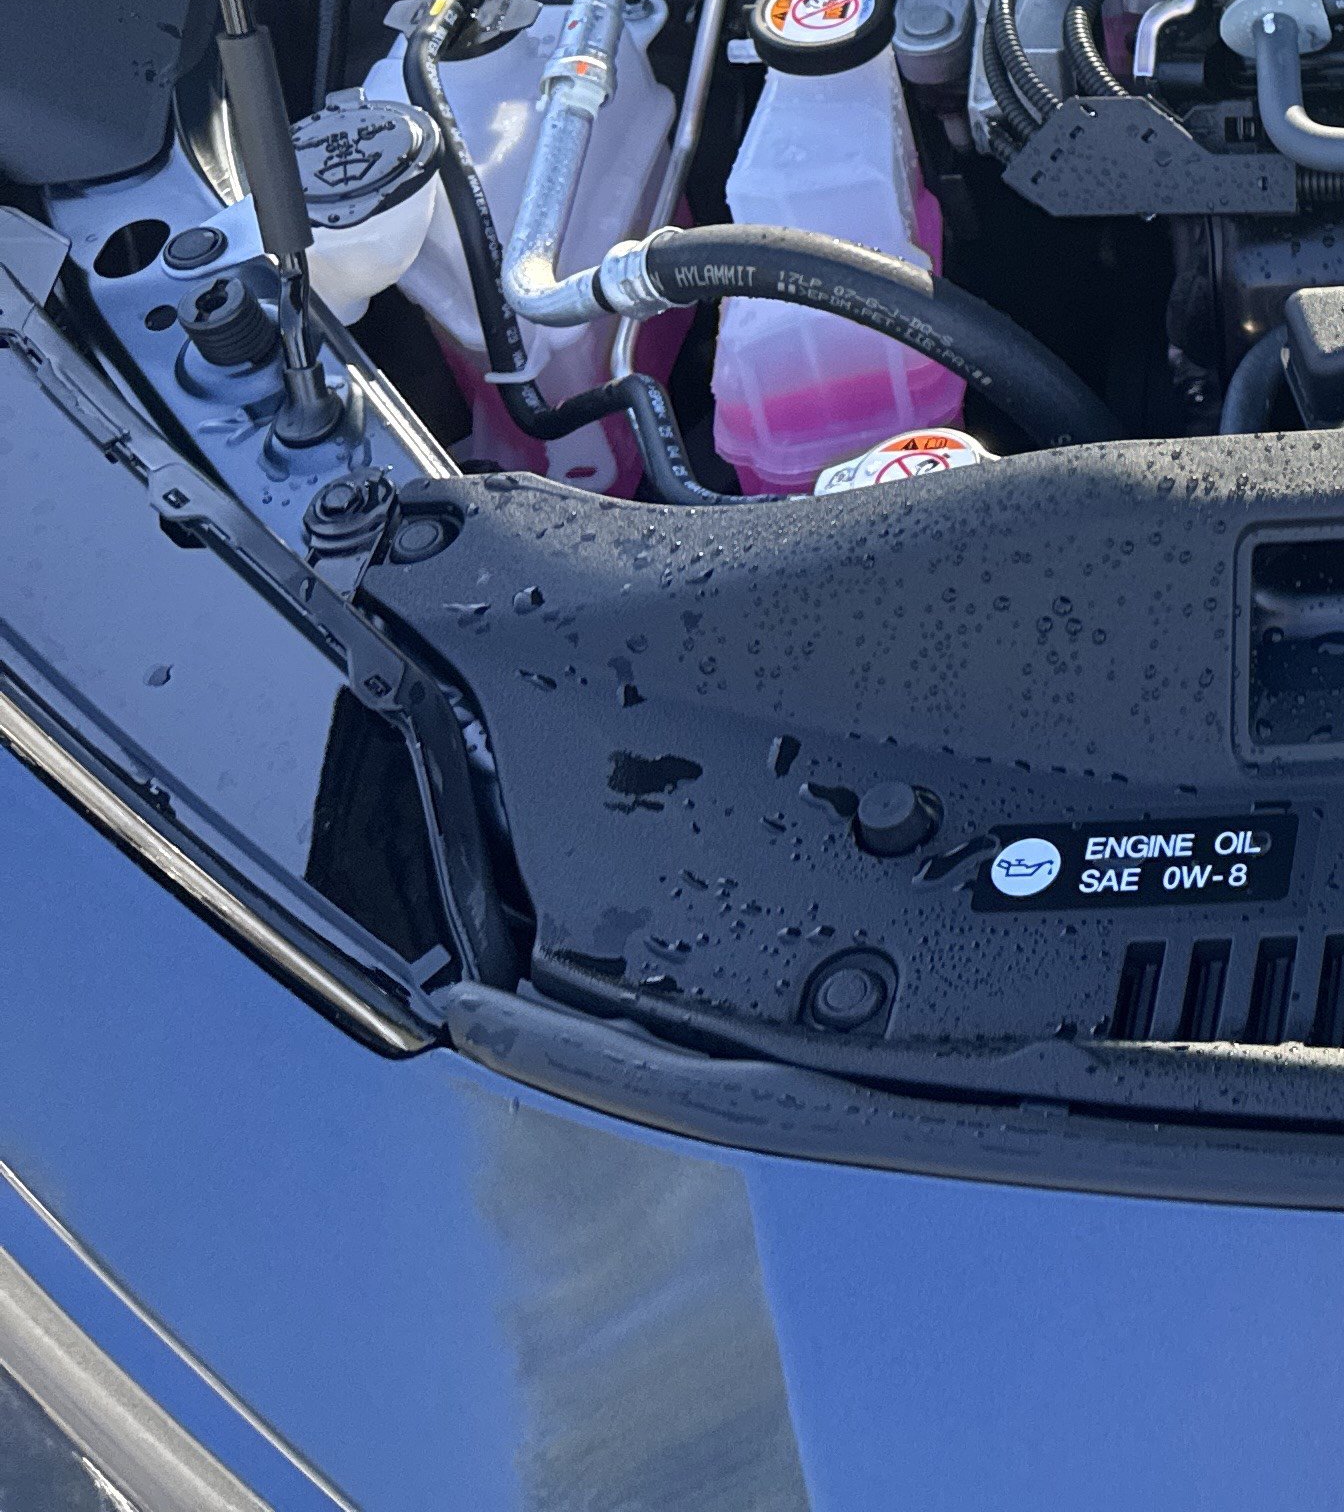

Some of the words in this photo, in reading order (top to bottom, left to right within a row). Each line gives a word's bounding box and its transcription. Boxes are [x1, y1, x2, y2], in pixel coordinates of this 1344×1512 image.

[467, 174, 489, 217] WATER
[1085, 833, 1195, 860] ENGINE
[1214, 831, 1262, 855] OIL
[1078, 867, 1141, 893] SAE
[1162, 864, 1248, 890] 0W-8
